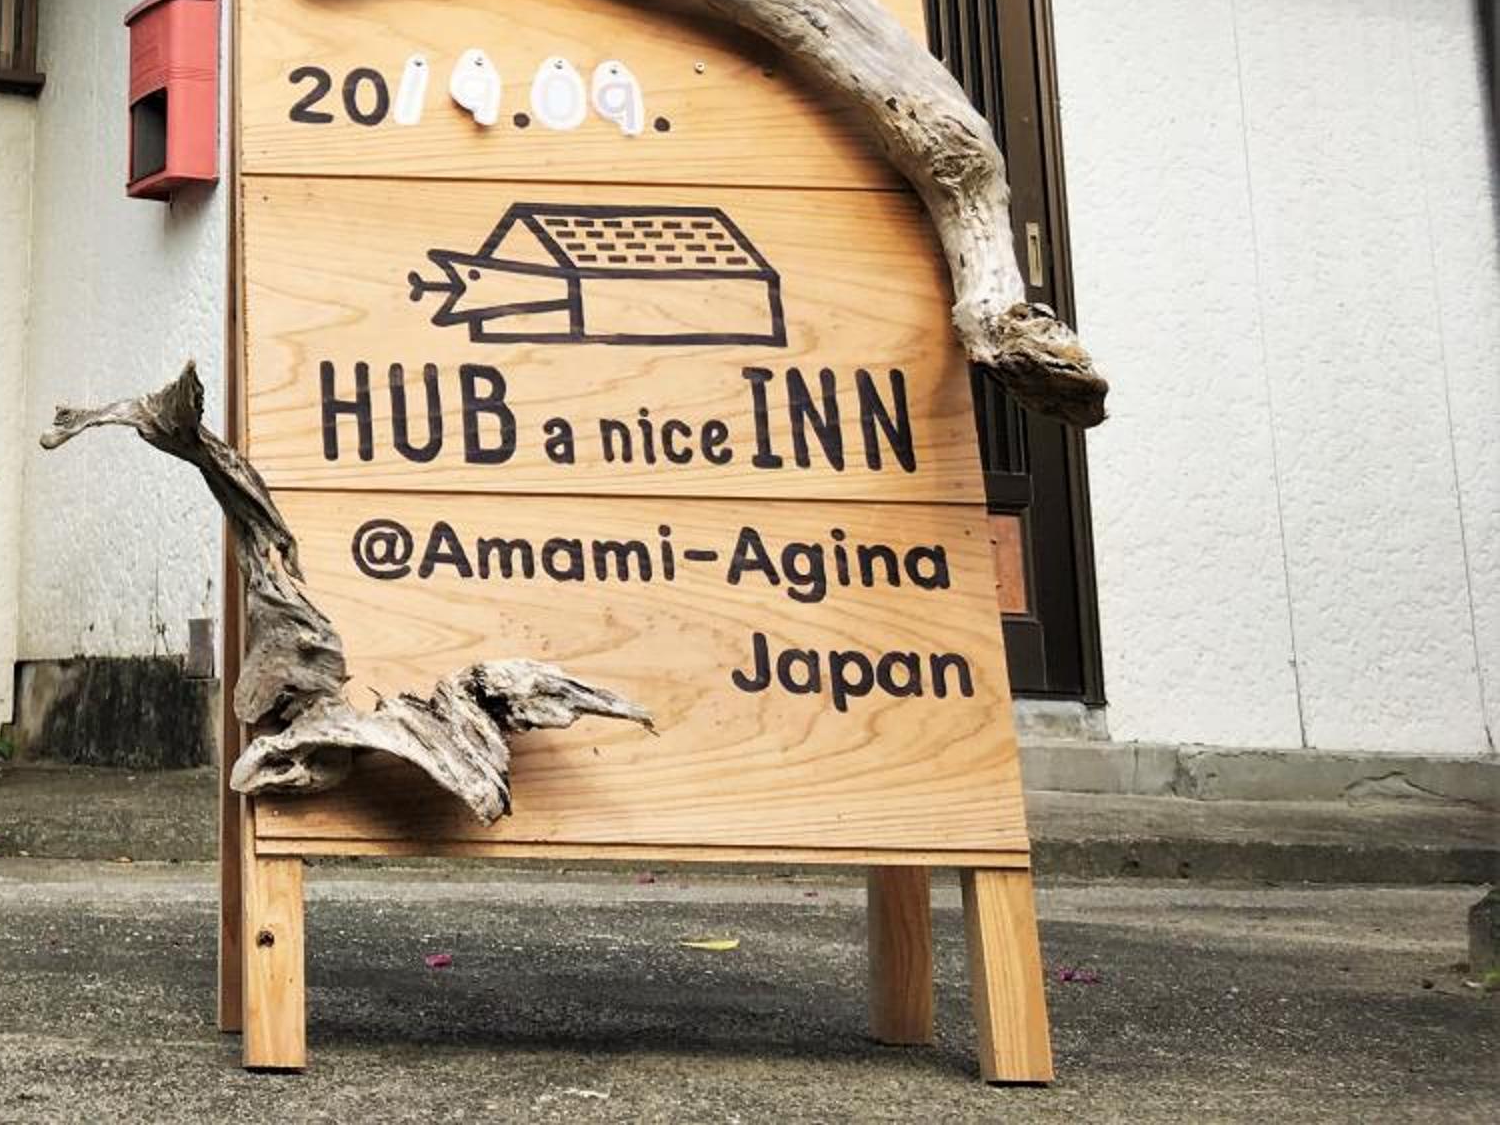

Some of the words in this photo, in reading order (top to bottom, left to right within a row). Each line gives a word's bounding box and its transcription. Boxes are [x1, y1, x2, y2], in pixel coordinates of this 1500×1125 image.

[319, 360, 518, 466] HUB
[543, 416, 576, 466] a
[599, 406, 734, 466] nice
[741, 365, 918, 474] INN
[350, 518, 952, 605] @Amami-Agina
[730, 631, 976, 714] Japan
